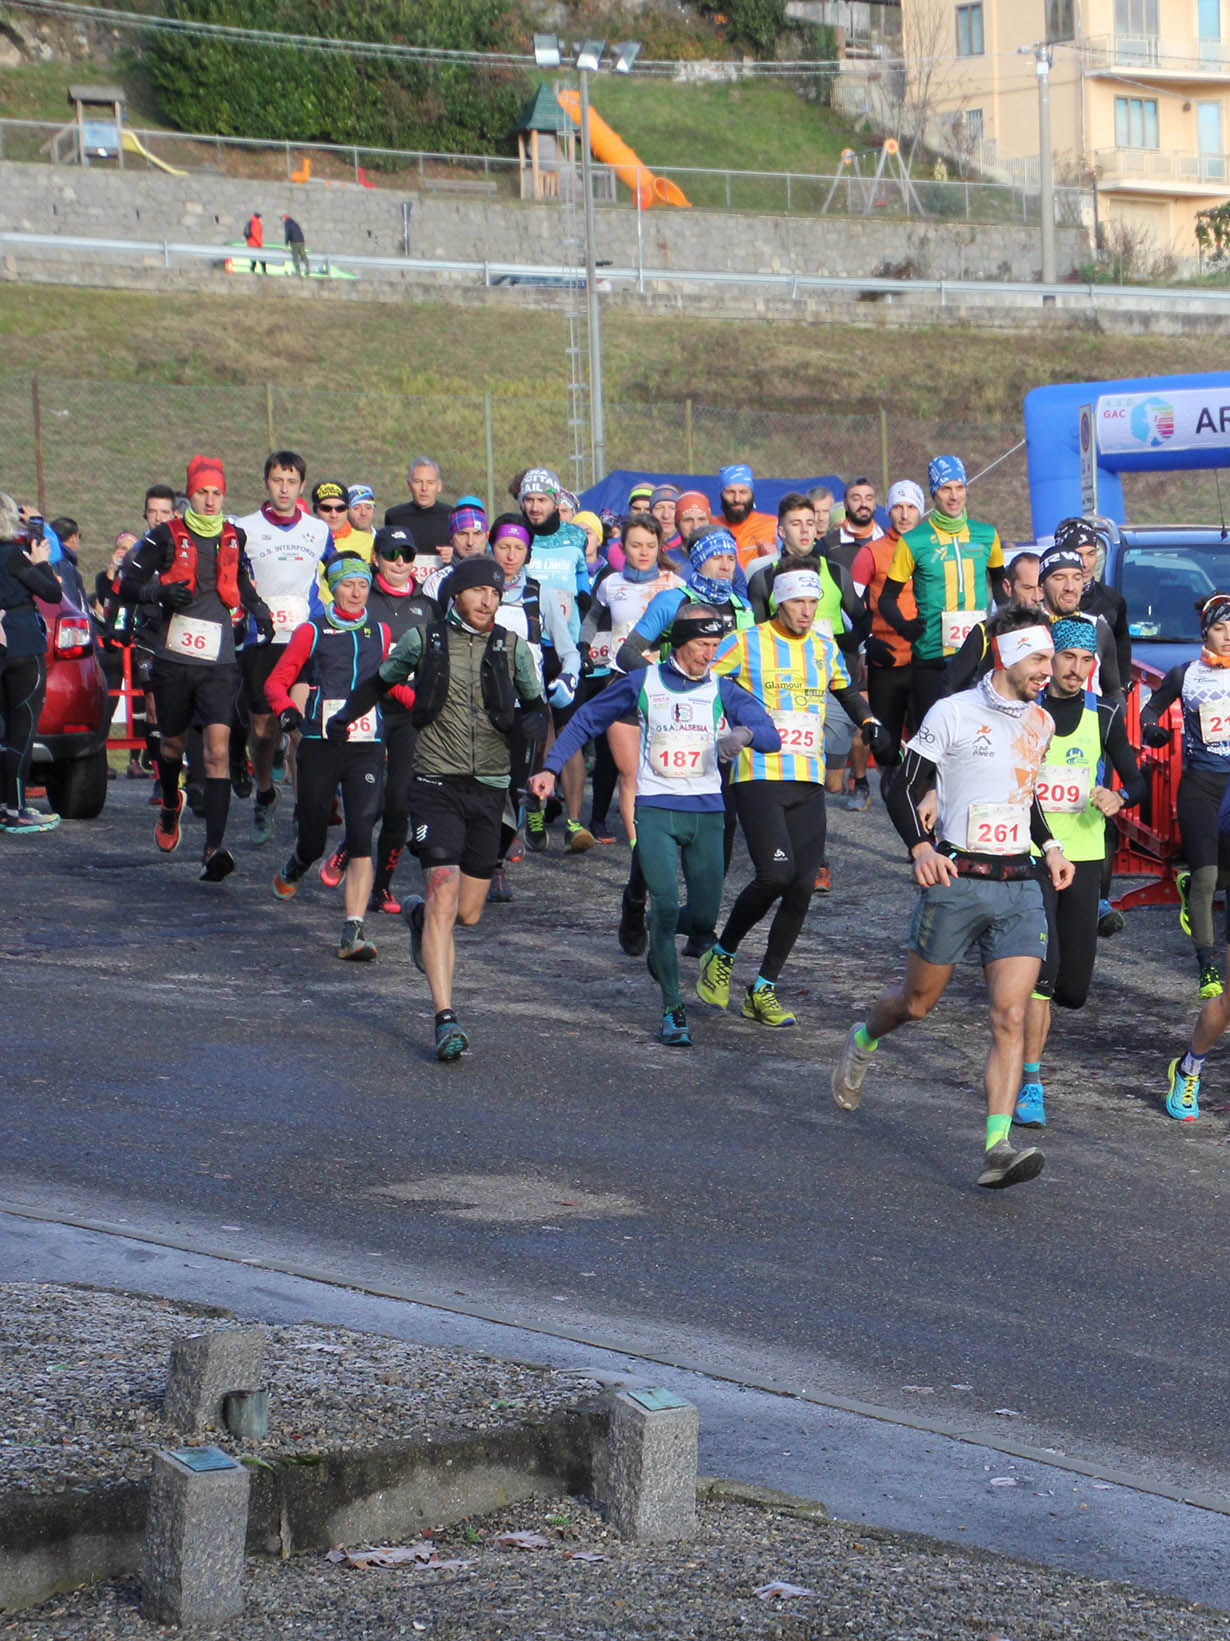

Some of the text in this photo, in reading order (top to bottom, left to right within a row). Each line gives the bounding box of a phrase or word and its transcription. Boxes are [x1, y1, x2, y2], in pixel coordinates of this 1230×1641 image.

[1103, 409, 1126, 419] GAC
[181, 632, 207, 649] 36
[765, 681, 802, 689] Glamour
[777, 728, 814, 747] 225
[658, 750, 701, 768] 187
[1036, 783, 1080, 803] 209
[977, 823, 1019, 842] 261
